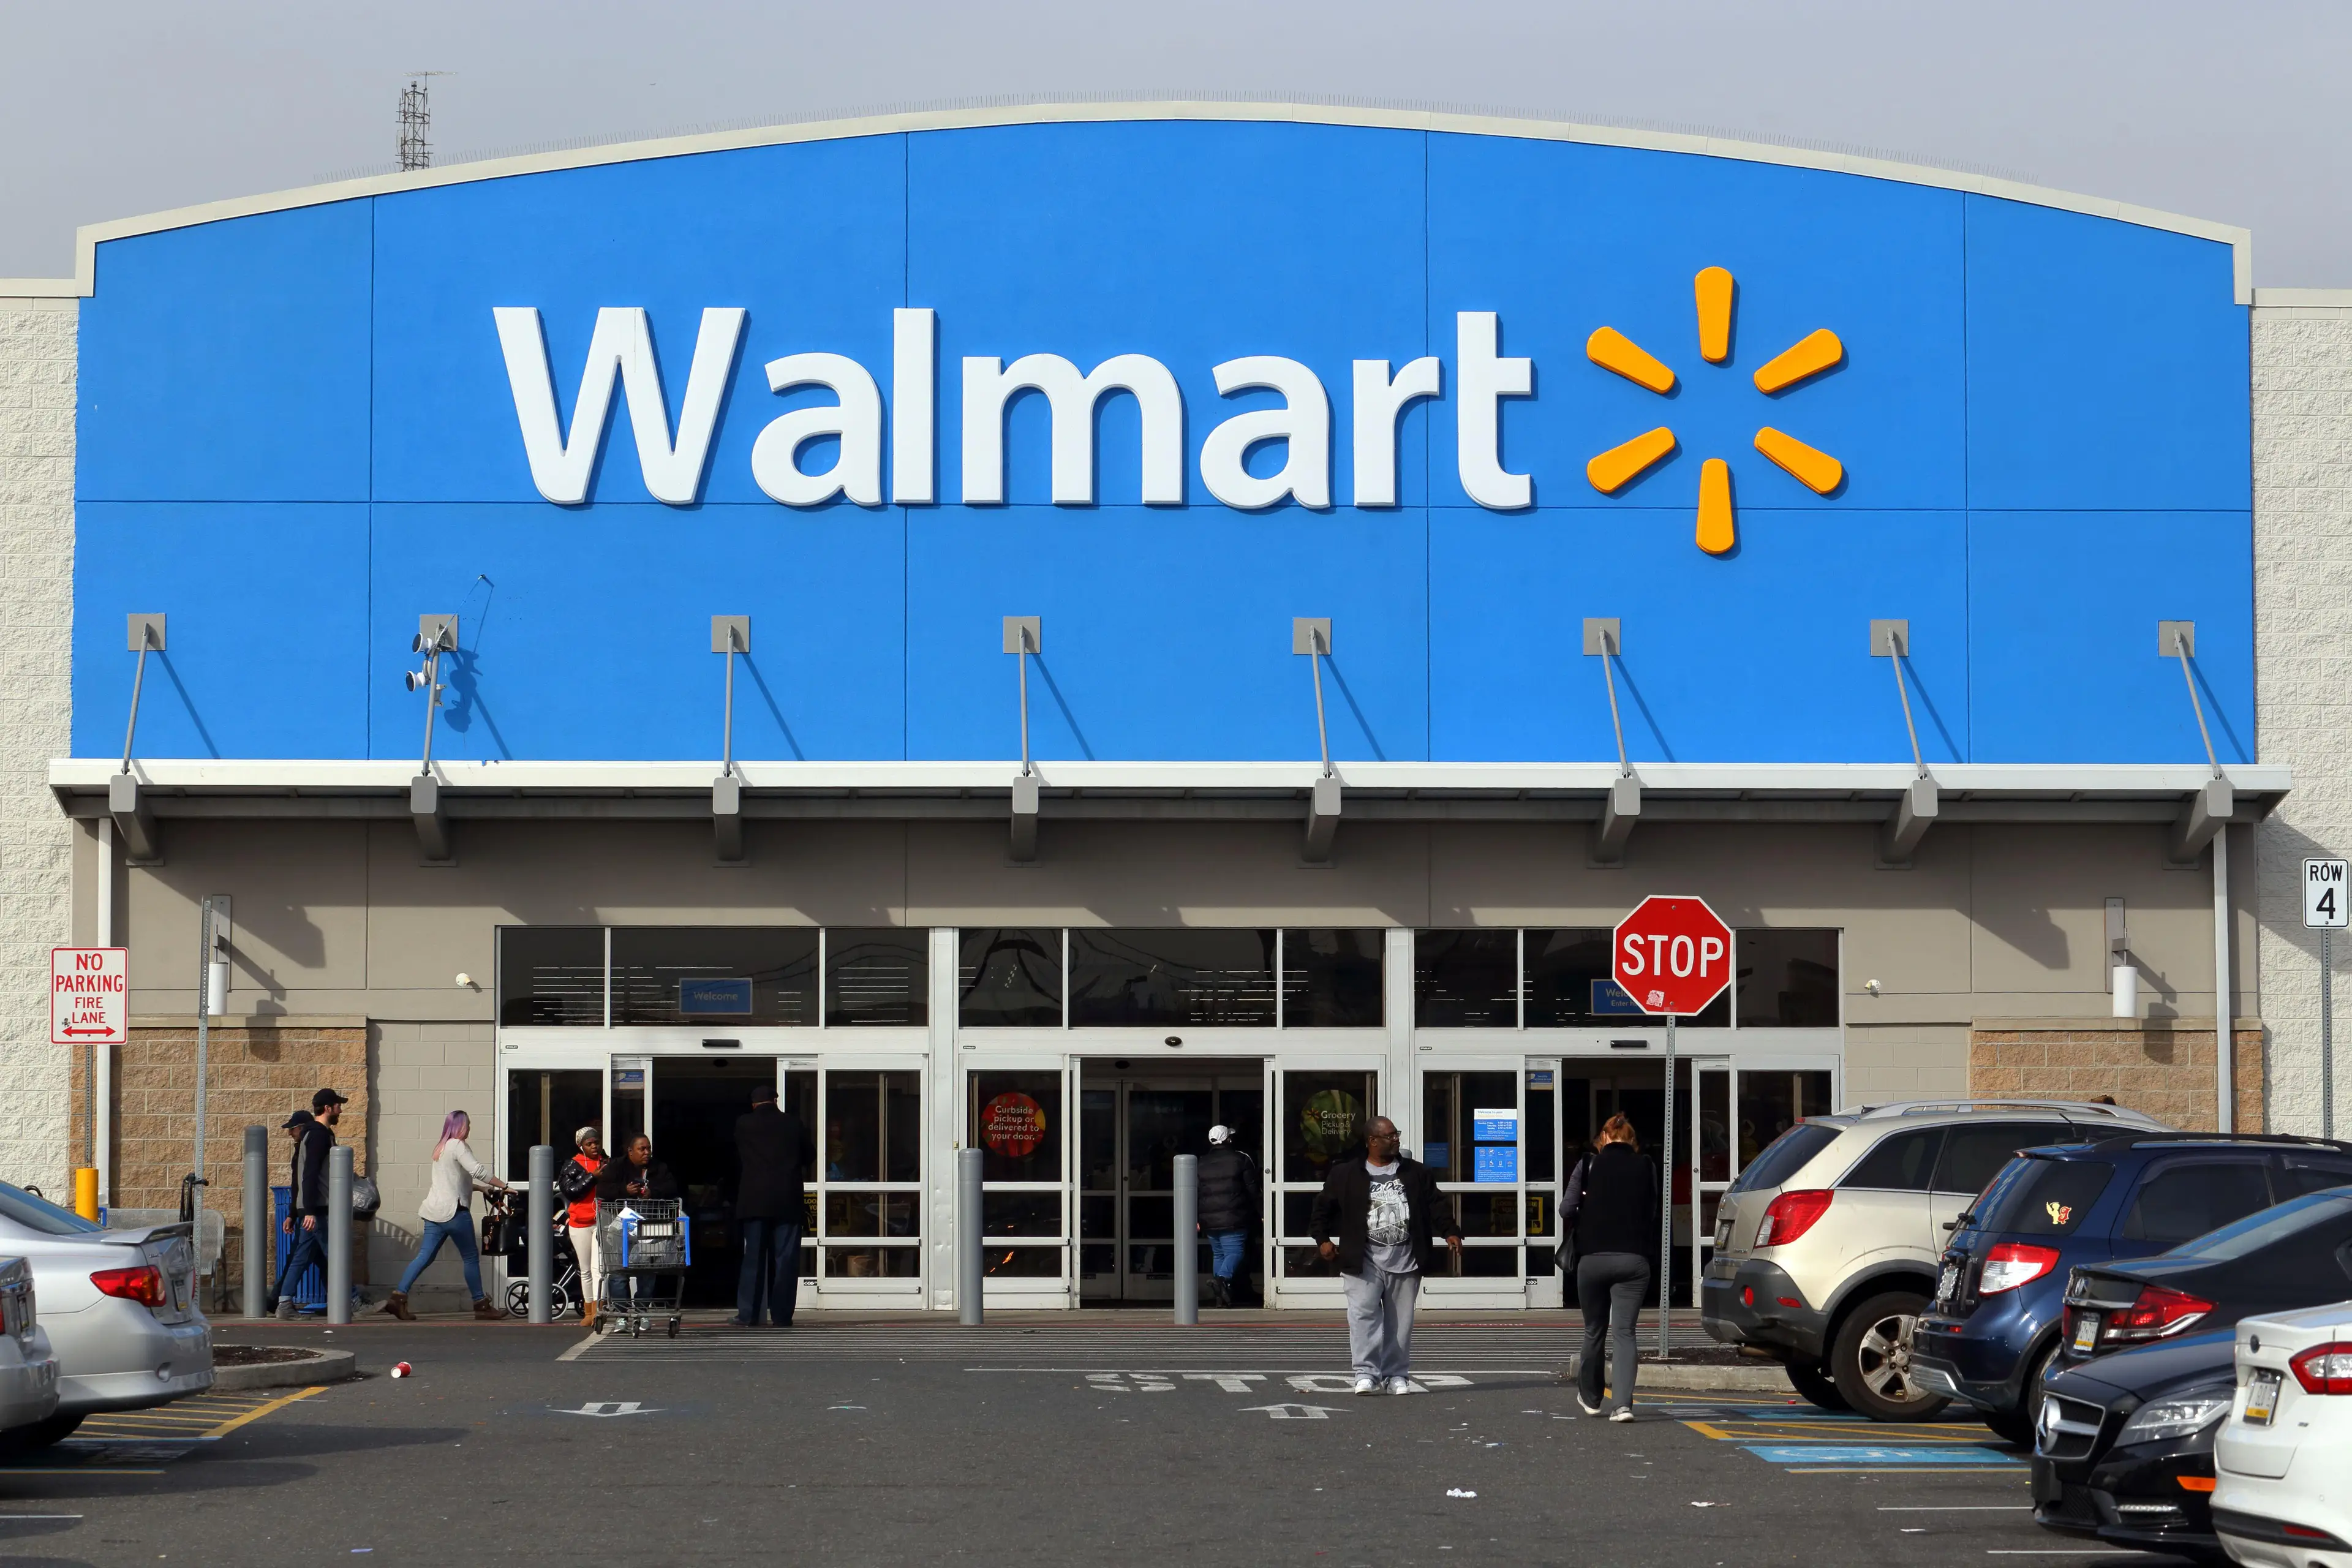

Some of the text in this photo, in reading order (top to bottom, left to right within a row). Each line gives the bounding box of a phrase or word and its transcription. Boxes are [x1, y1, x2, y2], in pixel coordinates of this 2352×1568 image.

[492, 306, 1532, 511] Walmart
[2310, 864, 2342, 881] ROW
[2316, 888, 2335, 919] 4
[1622, 933, 1724, 978] STOP
[76, 953, 103, 971] NO
[56, 974, 123, 992] PARKING
[693, 991, 738, 1001] Welcome
[1605, 988, 1629, 997] Welc
[75, 997, 104, 1009] FIRE
[72, 1012, 106, 1023] LANE
[994, 1115, 1022, 1125] pickup
[1321, 1110, 1355, 1121] Grocery
[1321, 1128, 1351, 1137] Delivery
